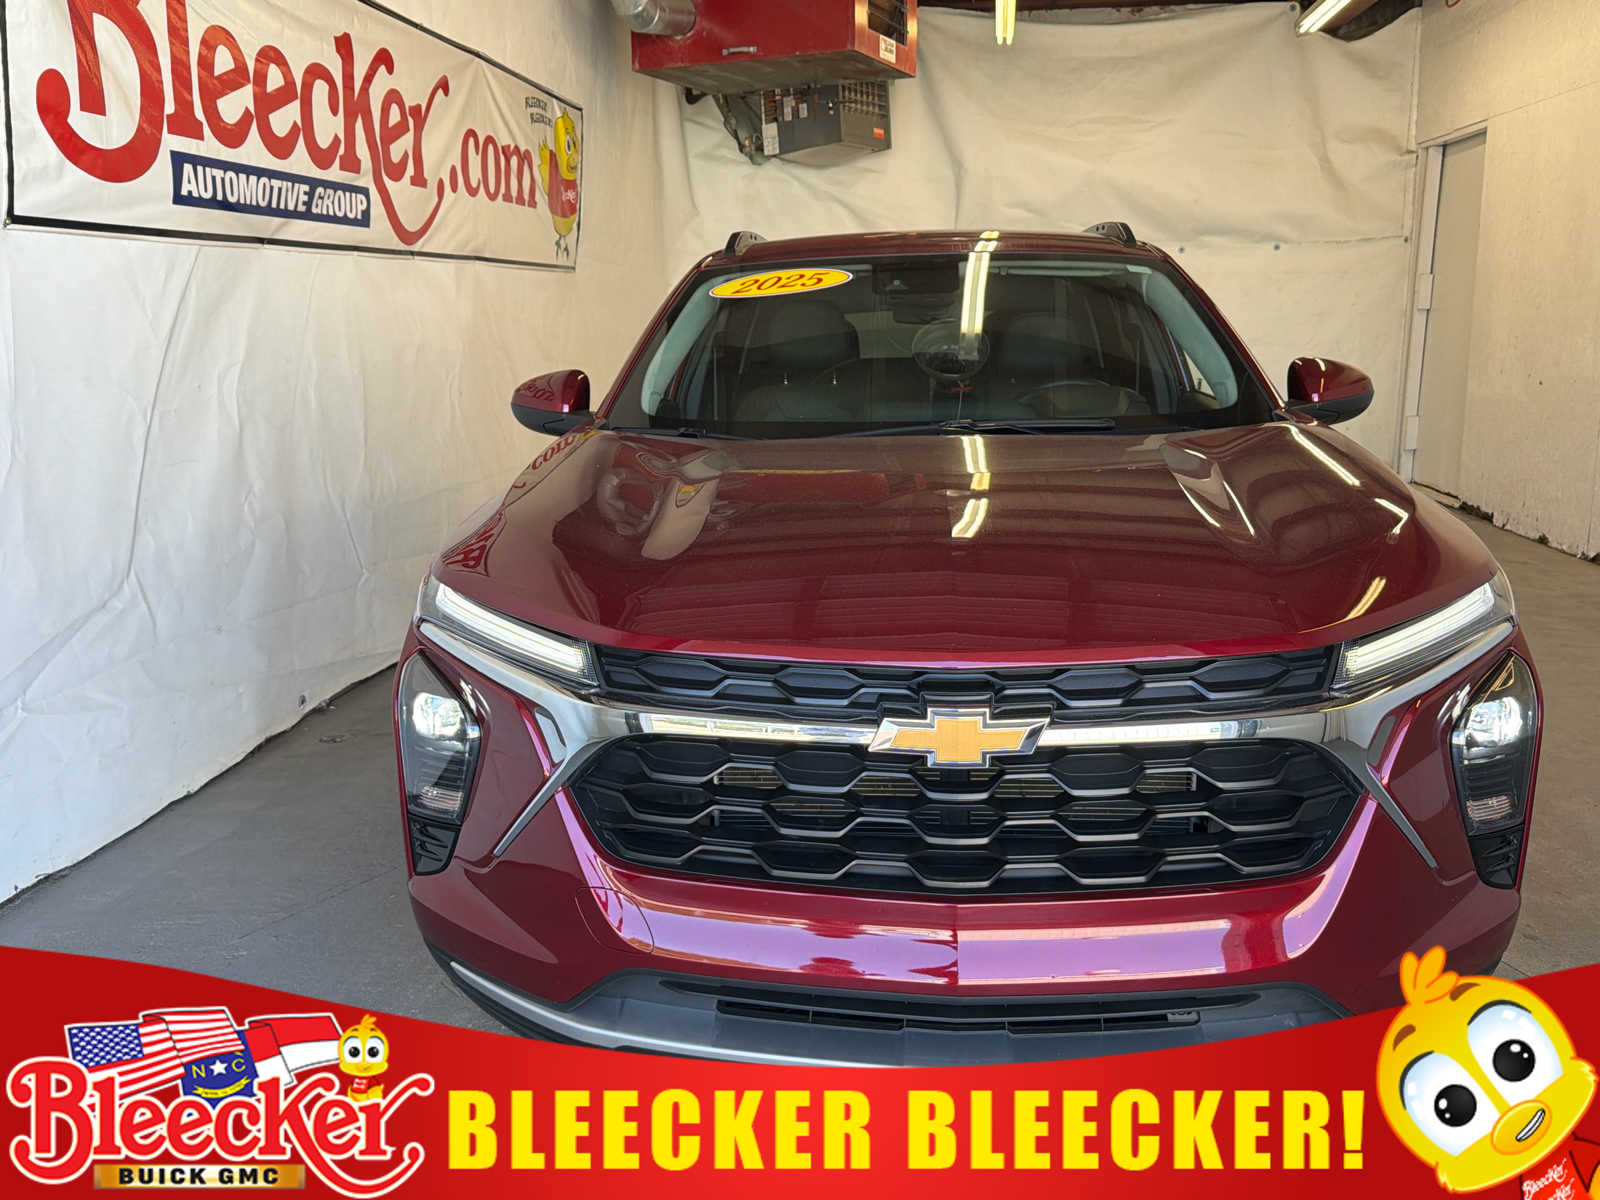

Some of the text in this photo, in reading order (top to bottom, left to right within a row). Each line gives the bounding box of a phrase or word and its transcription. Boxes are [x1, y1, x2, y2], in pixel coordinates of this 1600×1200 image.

[180, 163, 368, 220] AUTOMOTIVE GROUP
[731, 271, 831, 295] 2025
